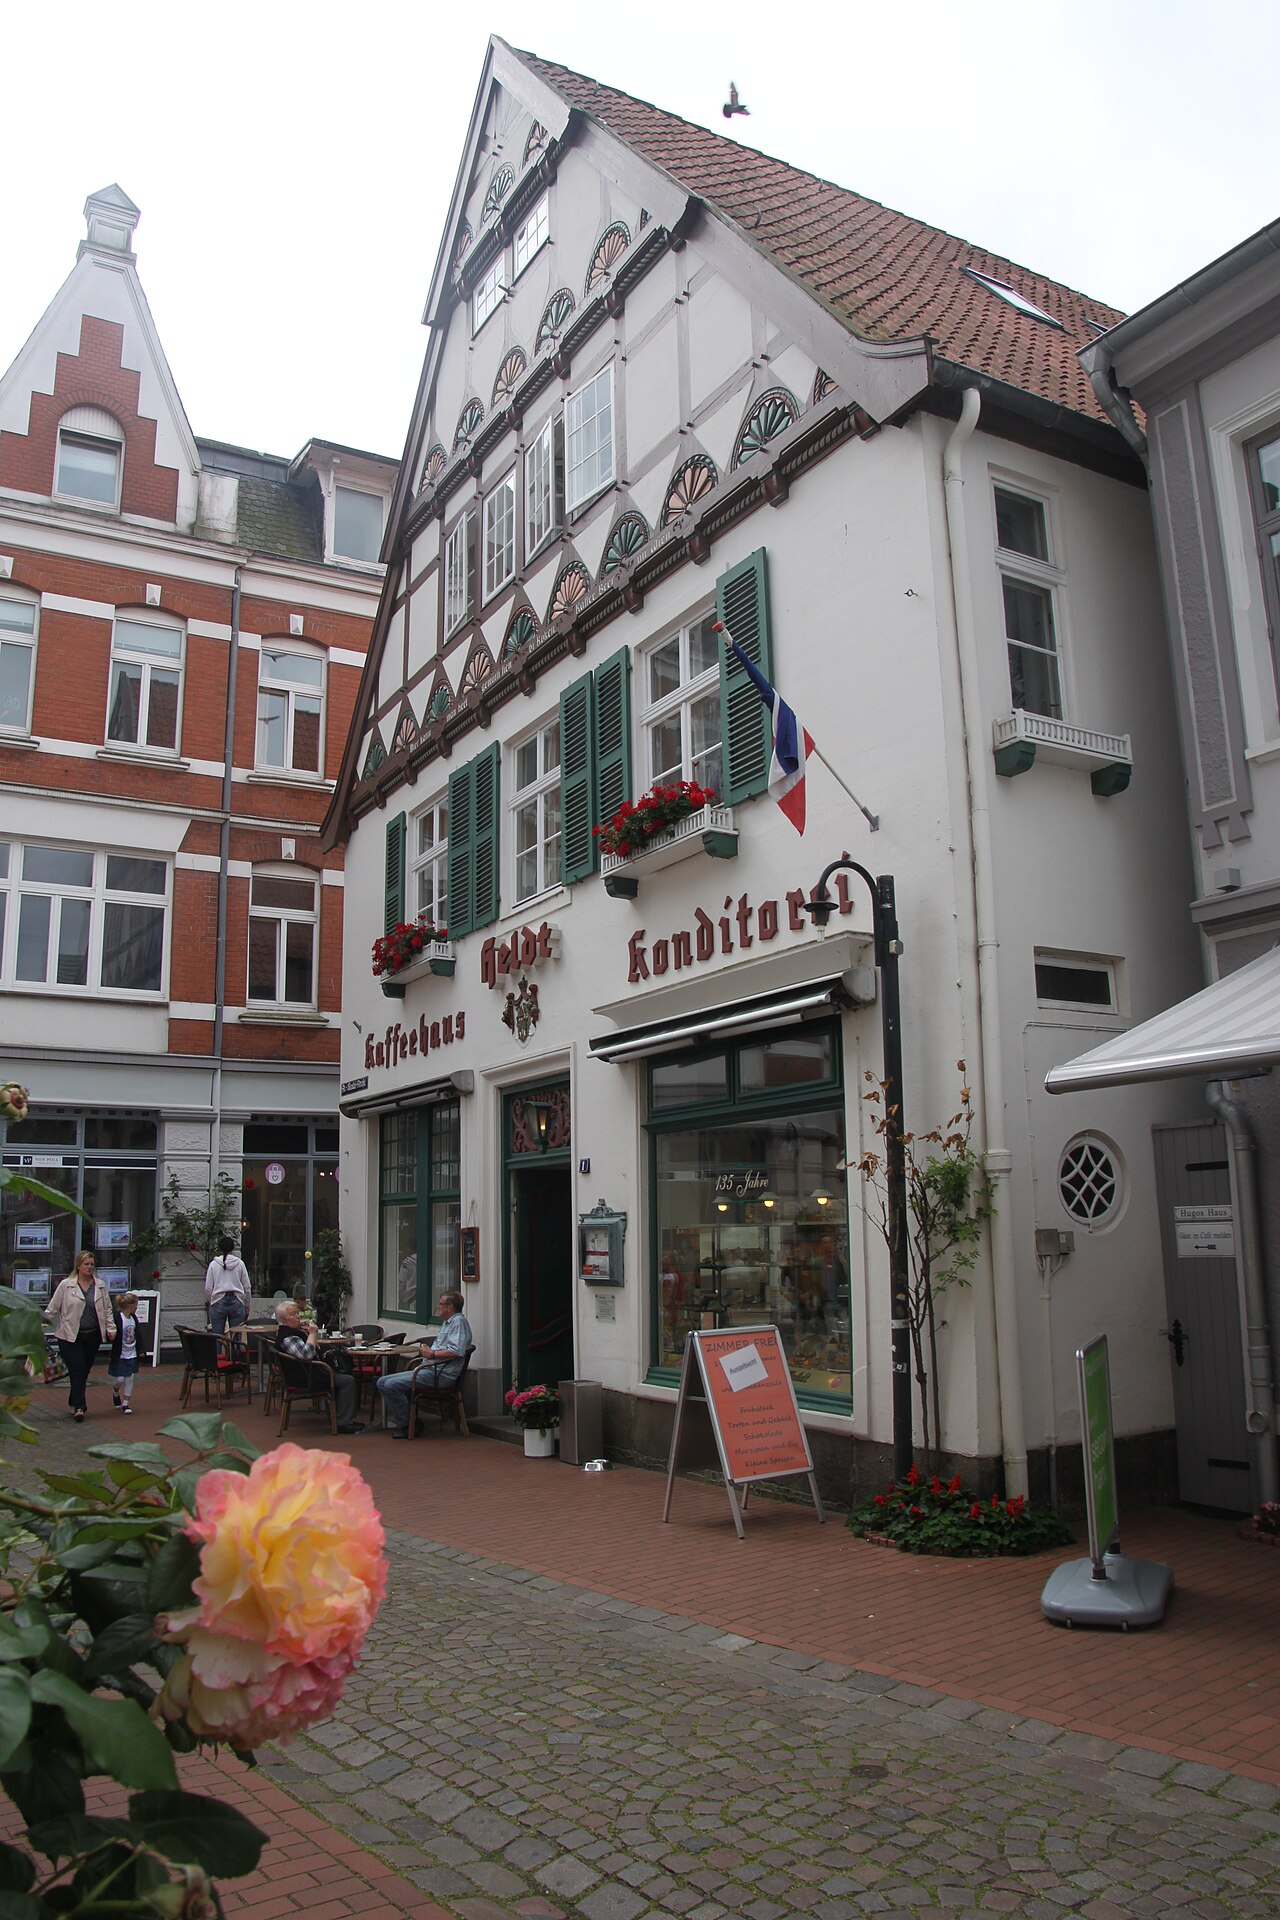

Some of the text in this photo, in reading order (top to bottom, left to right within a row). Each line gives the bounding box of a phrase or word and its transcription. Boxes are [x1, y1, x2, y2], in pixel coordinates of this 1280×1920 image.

[481, 920, 553, 990] Heldt
[364, 1010, 466, 1070] Kaffeehaus
[715, 1169, 769, 1198] 135 Jahre
[1180, 1208, 1227, 1219] Hugos Haus
[705, 1339, 749, 1353] ZIMMER
[729, 1358, 757, 1374] Ausgebucht
[752, 1418, 767, 1426] und
